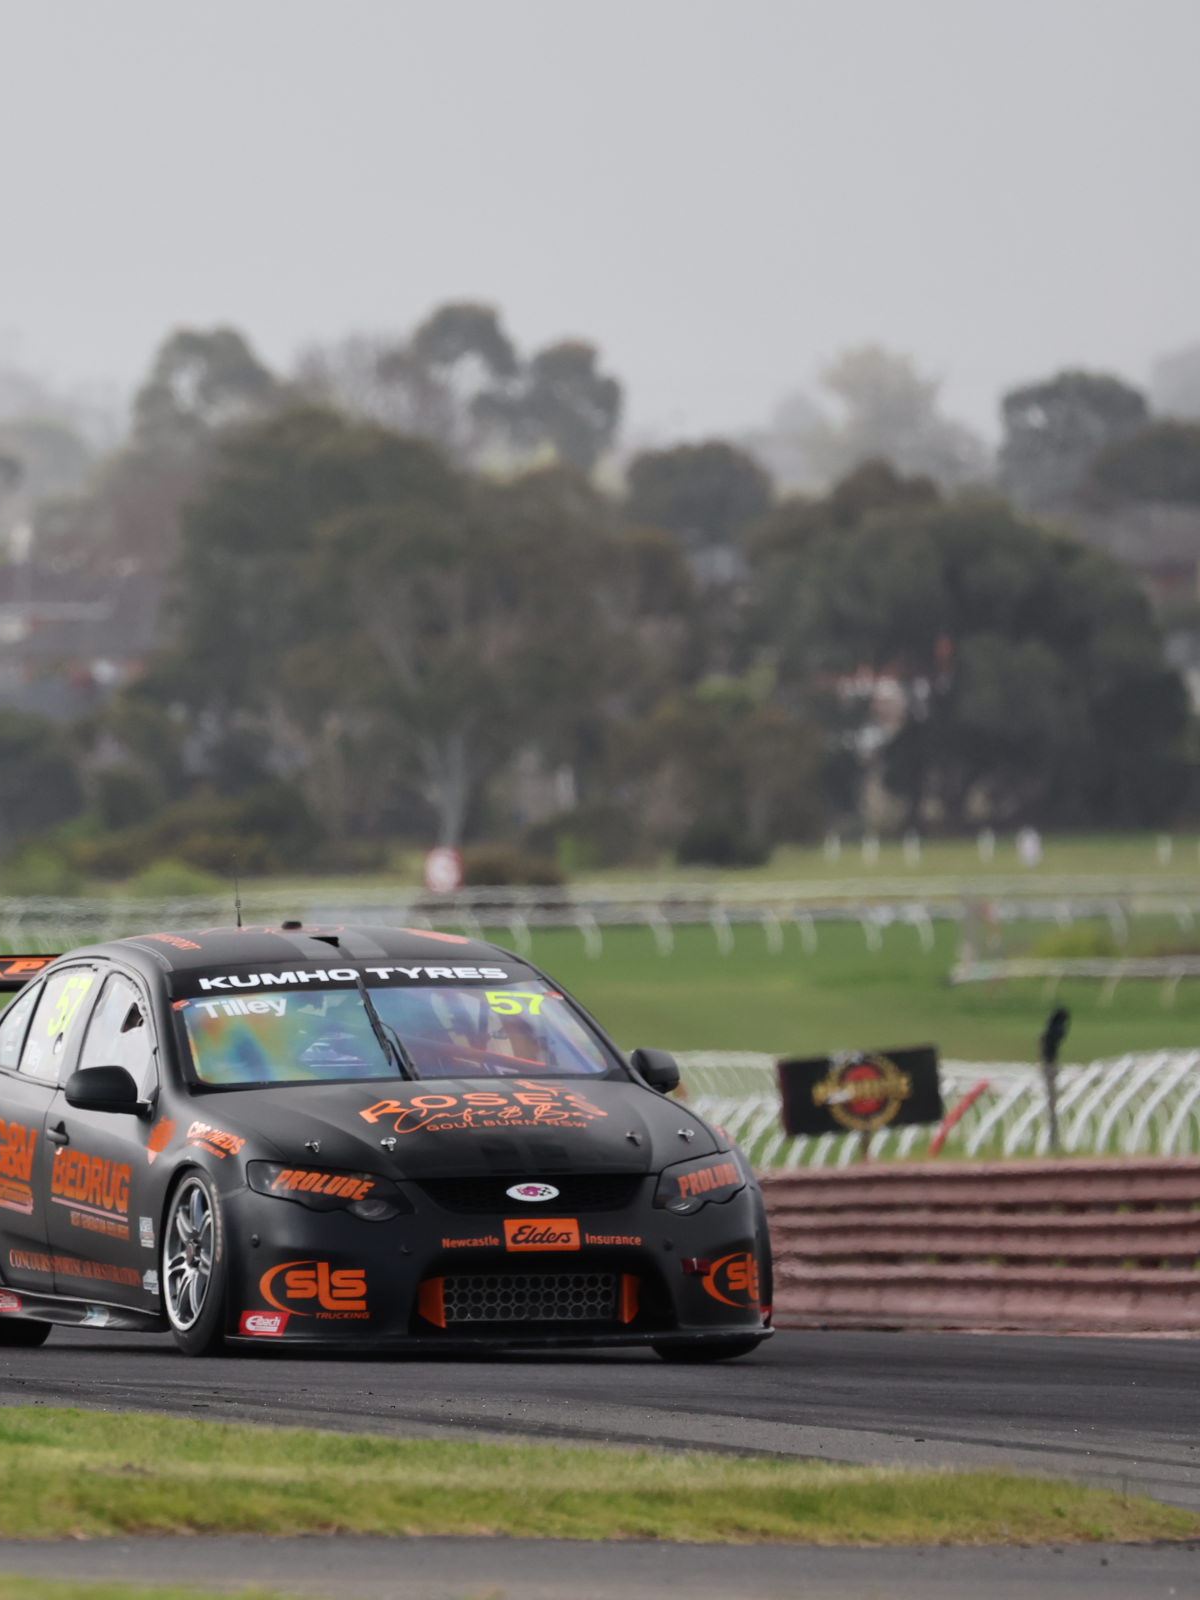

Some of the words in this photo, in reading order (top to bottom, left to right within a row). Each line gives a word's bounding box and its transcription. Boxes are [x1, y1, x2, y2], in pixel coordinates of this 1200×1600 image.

[198, 967, 360, 991] KUMHO
[364, 966, 508, 981] TYRES
[46, 977, 94, 1037] 57
[195, 998, 288, 1019] Tilley
[485, 991, 545, 1015] 57
[426, 1119, 538, 1132] GOULBURN
[51, 1148, 133, 1214] BEDRUG
[271, 1169, 376, 1201] PROLUBE
[442, 1236, 500, 1248] Newcastle
[510, 1225, 574, 1245] Elders
[584, 1233, 643, 1246] Insurance
[314, 1312, 371, 1320] TRUCKING
